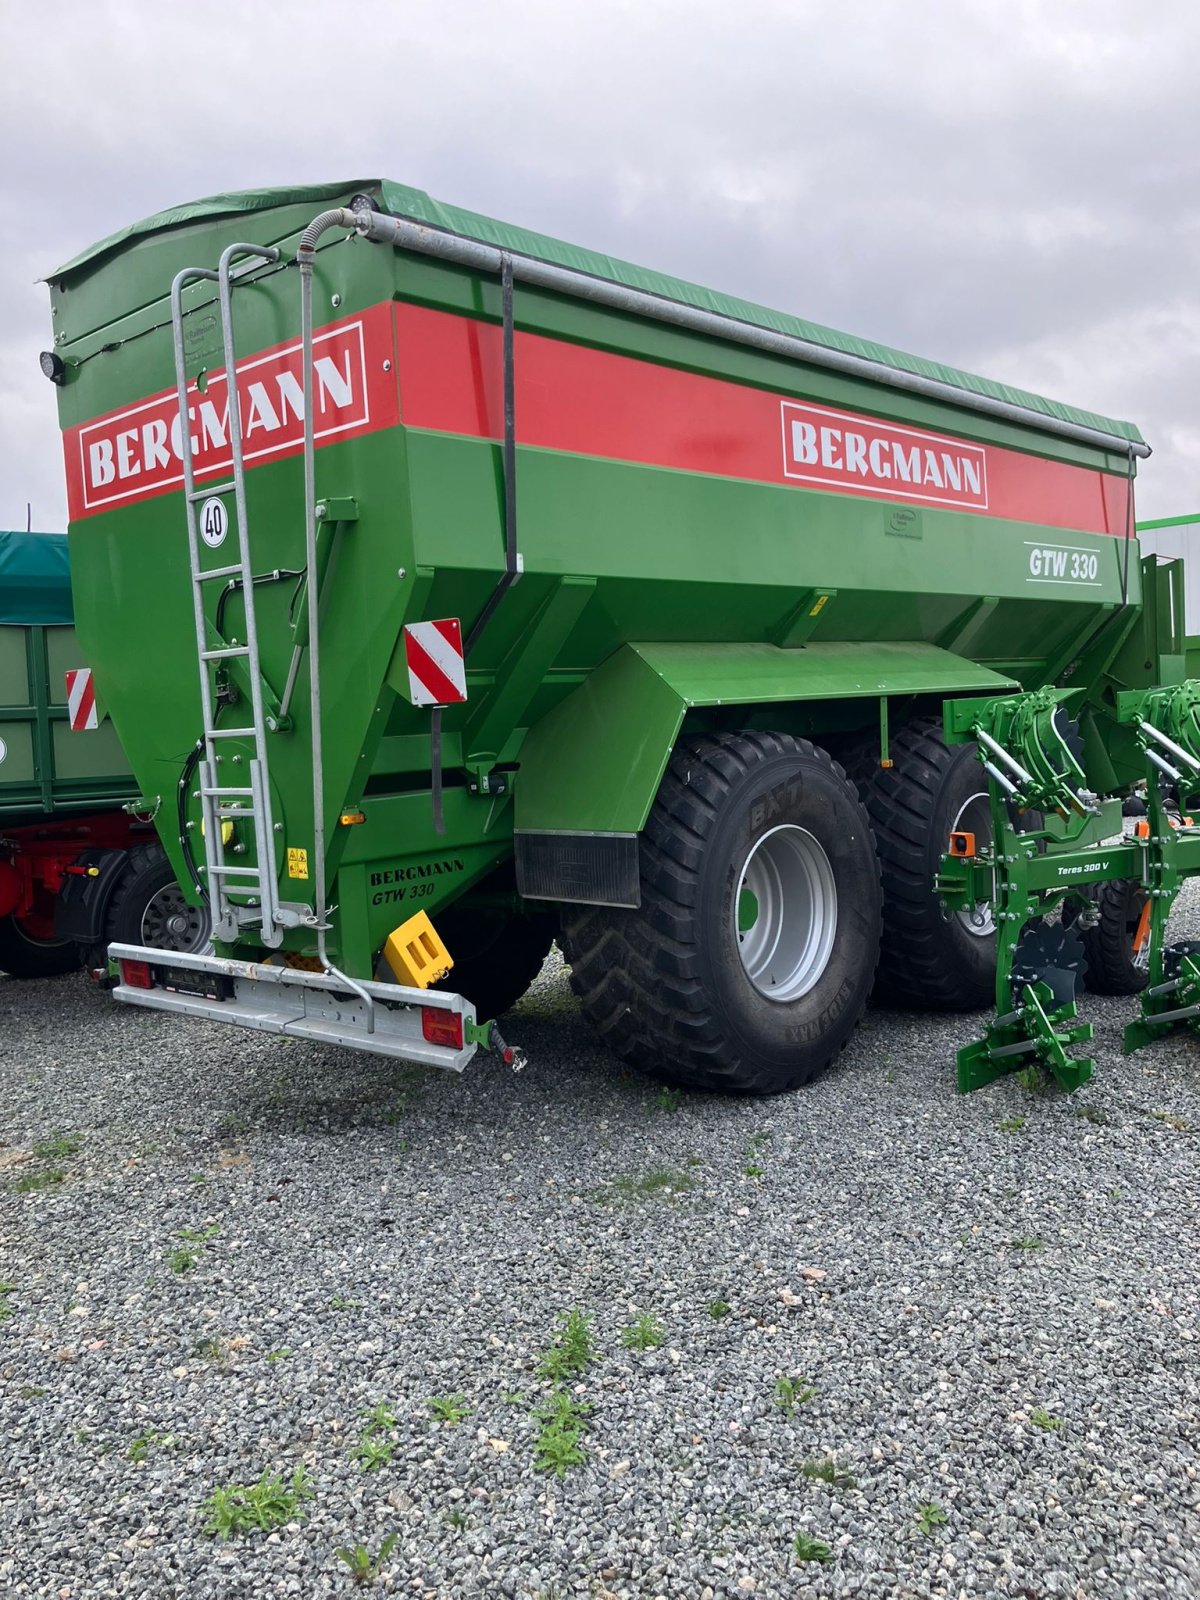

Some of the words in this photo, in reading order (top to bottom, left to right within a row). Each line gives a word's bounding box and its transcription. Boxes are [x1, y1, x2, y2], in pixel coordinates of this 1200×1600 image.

[89, 349, 353, 488] BERGMANN
[791, 420, 981, 494] BERGMANN
[206, 505, 222, 537] 40
[1030, 548, 1067, 577] GTW
[1070, 553, 1098, 580] 330
[370, 859, 465, 886] BERGMANN
[1058, 866, 1082, 875] Teres
[1083, 863, 1101, 872] 300
[1102, 862, 1109, 870] V
[372, 887, 406, 906] GTW
[409, 883, 435, 899] 330
